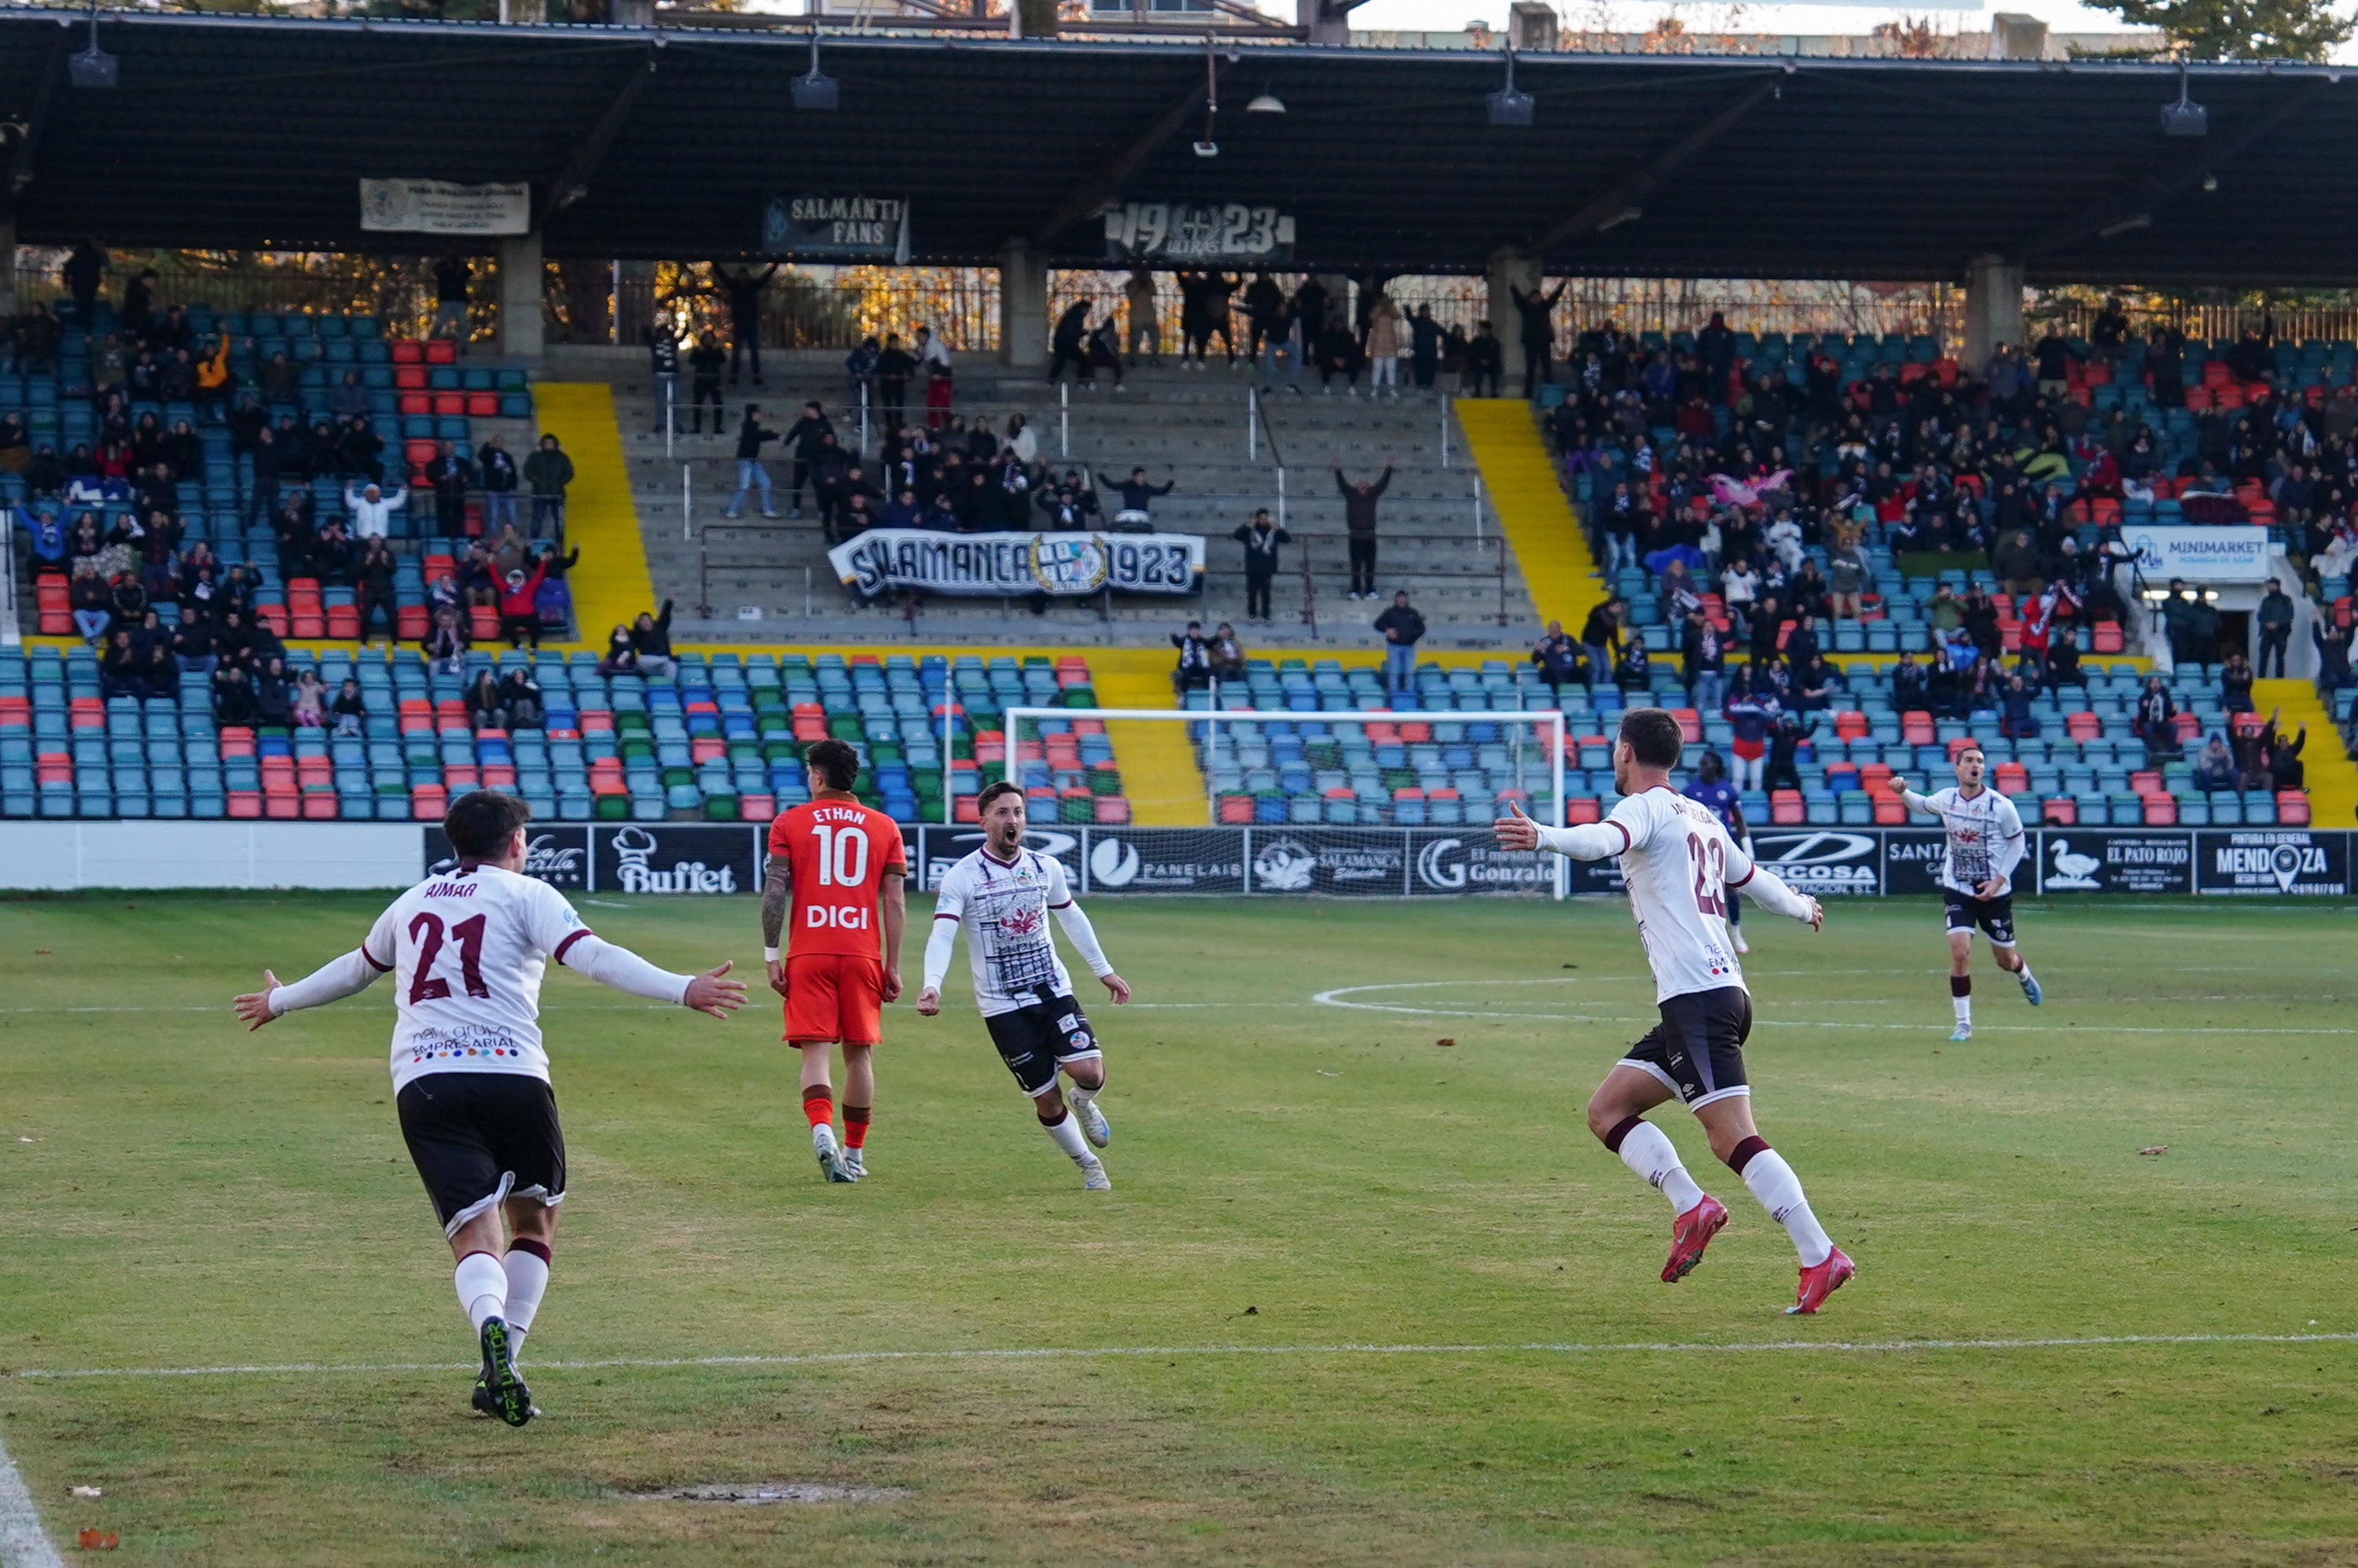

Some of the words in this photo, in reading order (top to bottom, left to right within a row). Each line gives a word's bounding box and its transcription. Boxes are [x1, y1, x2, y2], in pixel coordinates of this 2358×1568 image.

[832, 222, 885, 243] FANS
[1119, 203, 1169, 254] 19
[1221, 203, 1277, 254] 23
[2169, 541, 2264, 553] MINIMARKET
[1104, 542, 1192, 586] 1923
[813, 806, 865, 825] ETHAN
[810, 824, 869, 887] 10
[2107, 846, 2122, 863] EL
[2125, 846, 2155, 863] PATO
[2156, 846, 2189, 865] ROJO
[617, 861, 737, 894] Buffet
[1469, 863, 1555, 882] Gonzalo
[1687, 831, 1727, 919] 23
[1757, 865, 1877, 879] SCOSA
[424, 882, 478, 899] AIMAR
[806, 905, 869, 930] DIGI
[407, 911, 490, 1006] 21
